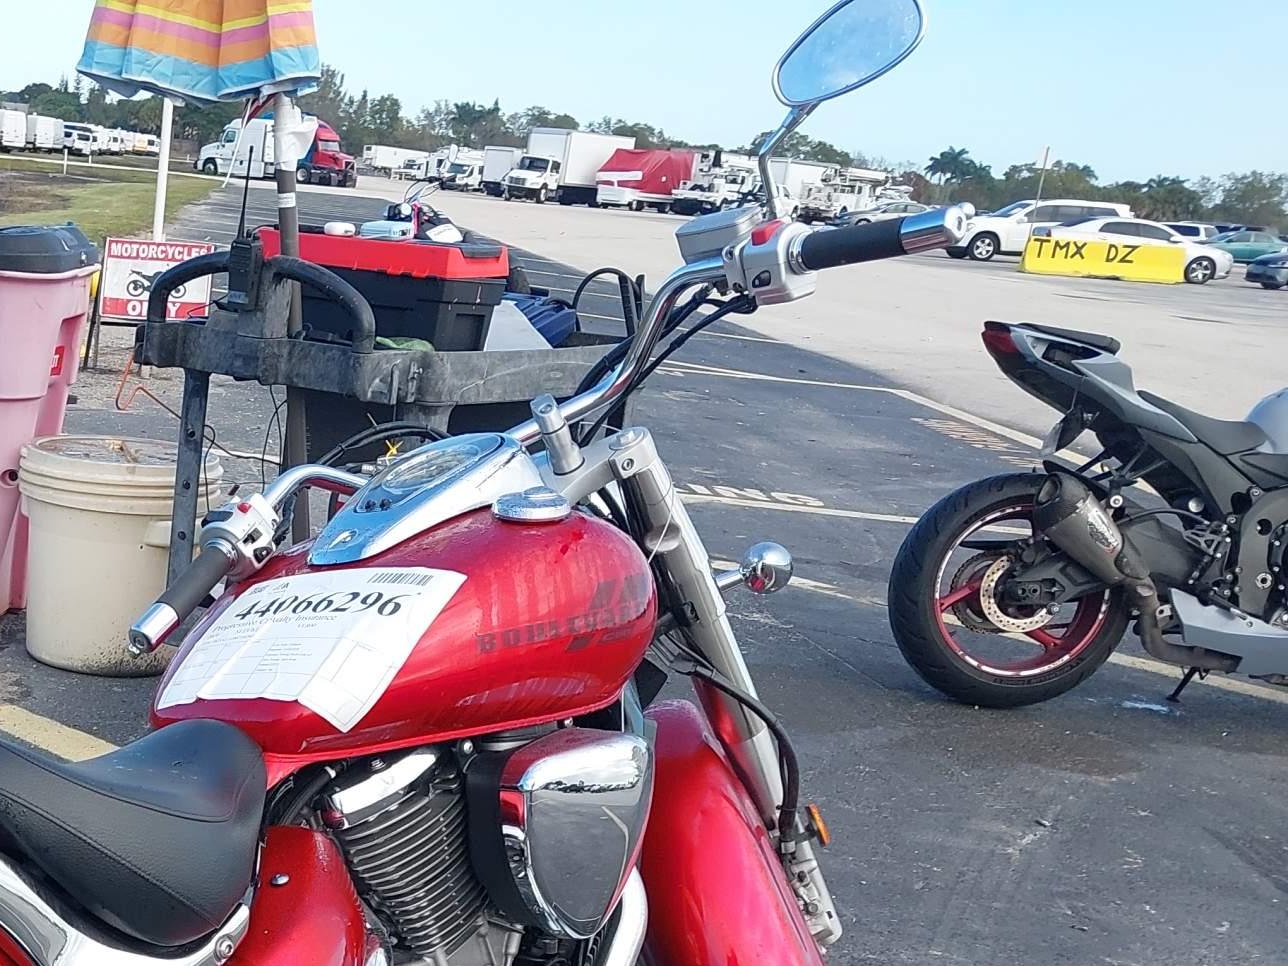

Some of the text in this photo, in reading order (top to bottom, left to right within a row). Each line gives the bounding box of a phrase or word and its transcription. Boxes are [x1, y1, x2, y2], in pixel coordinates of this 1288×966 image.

[1034, 238, 1141, 264] TMX DZ
[126, 300, 181, 318] OY
[234, 591, 418, 620] 44066296
